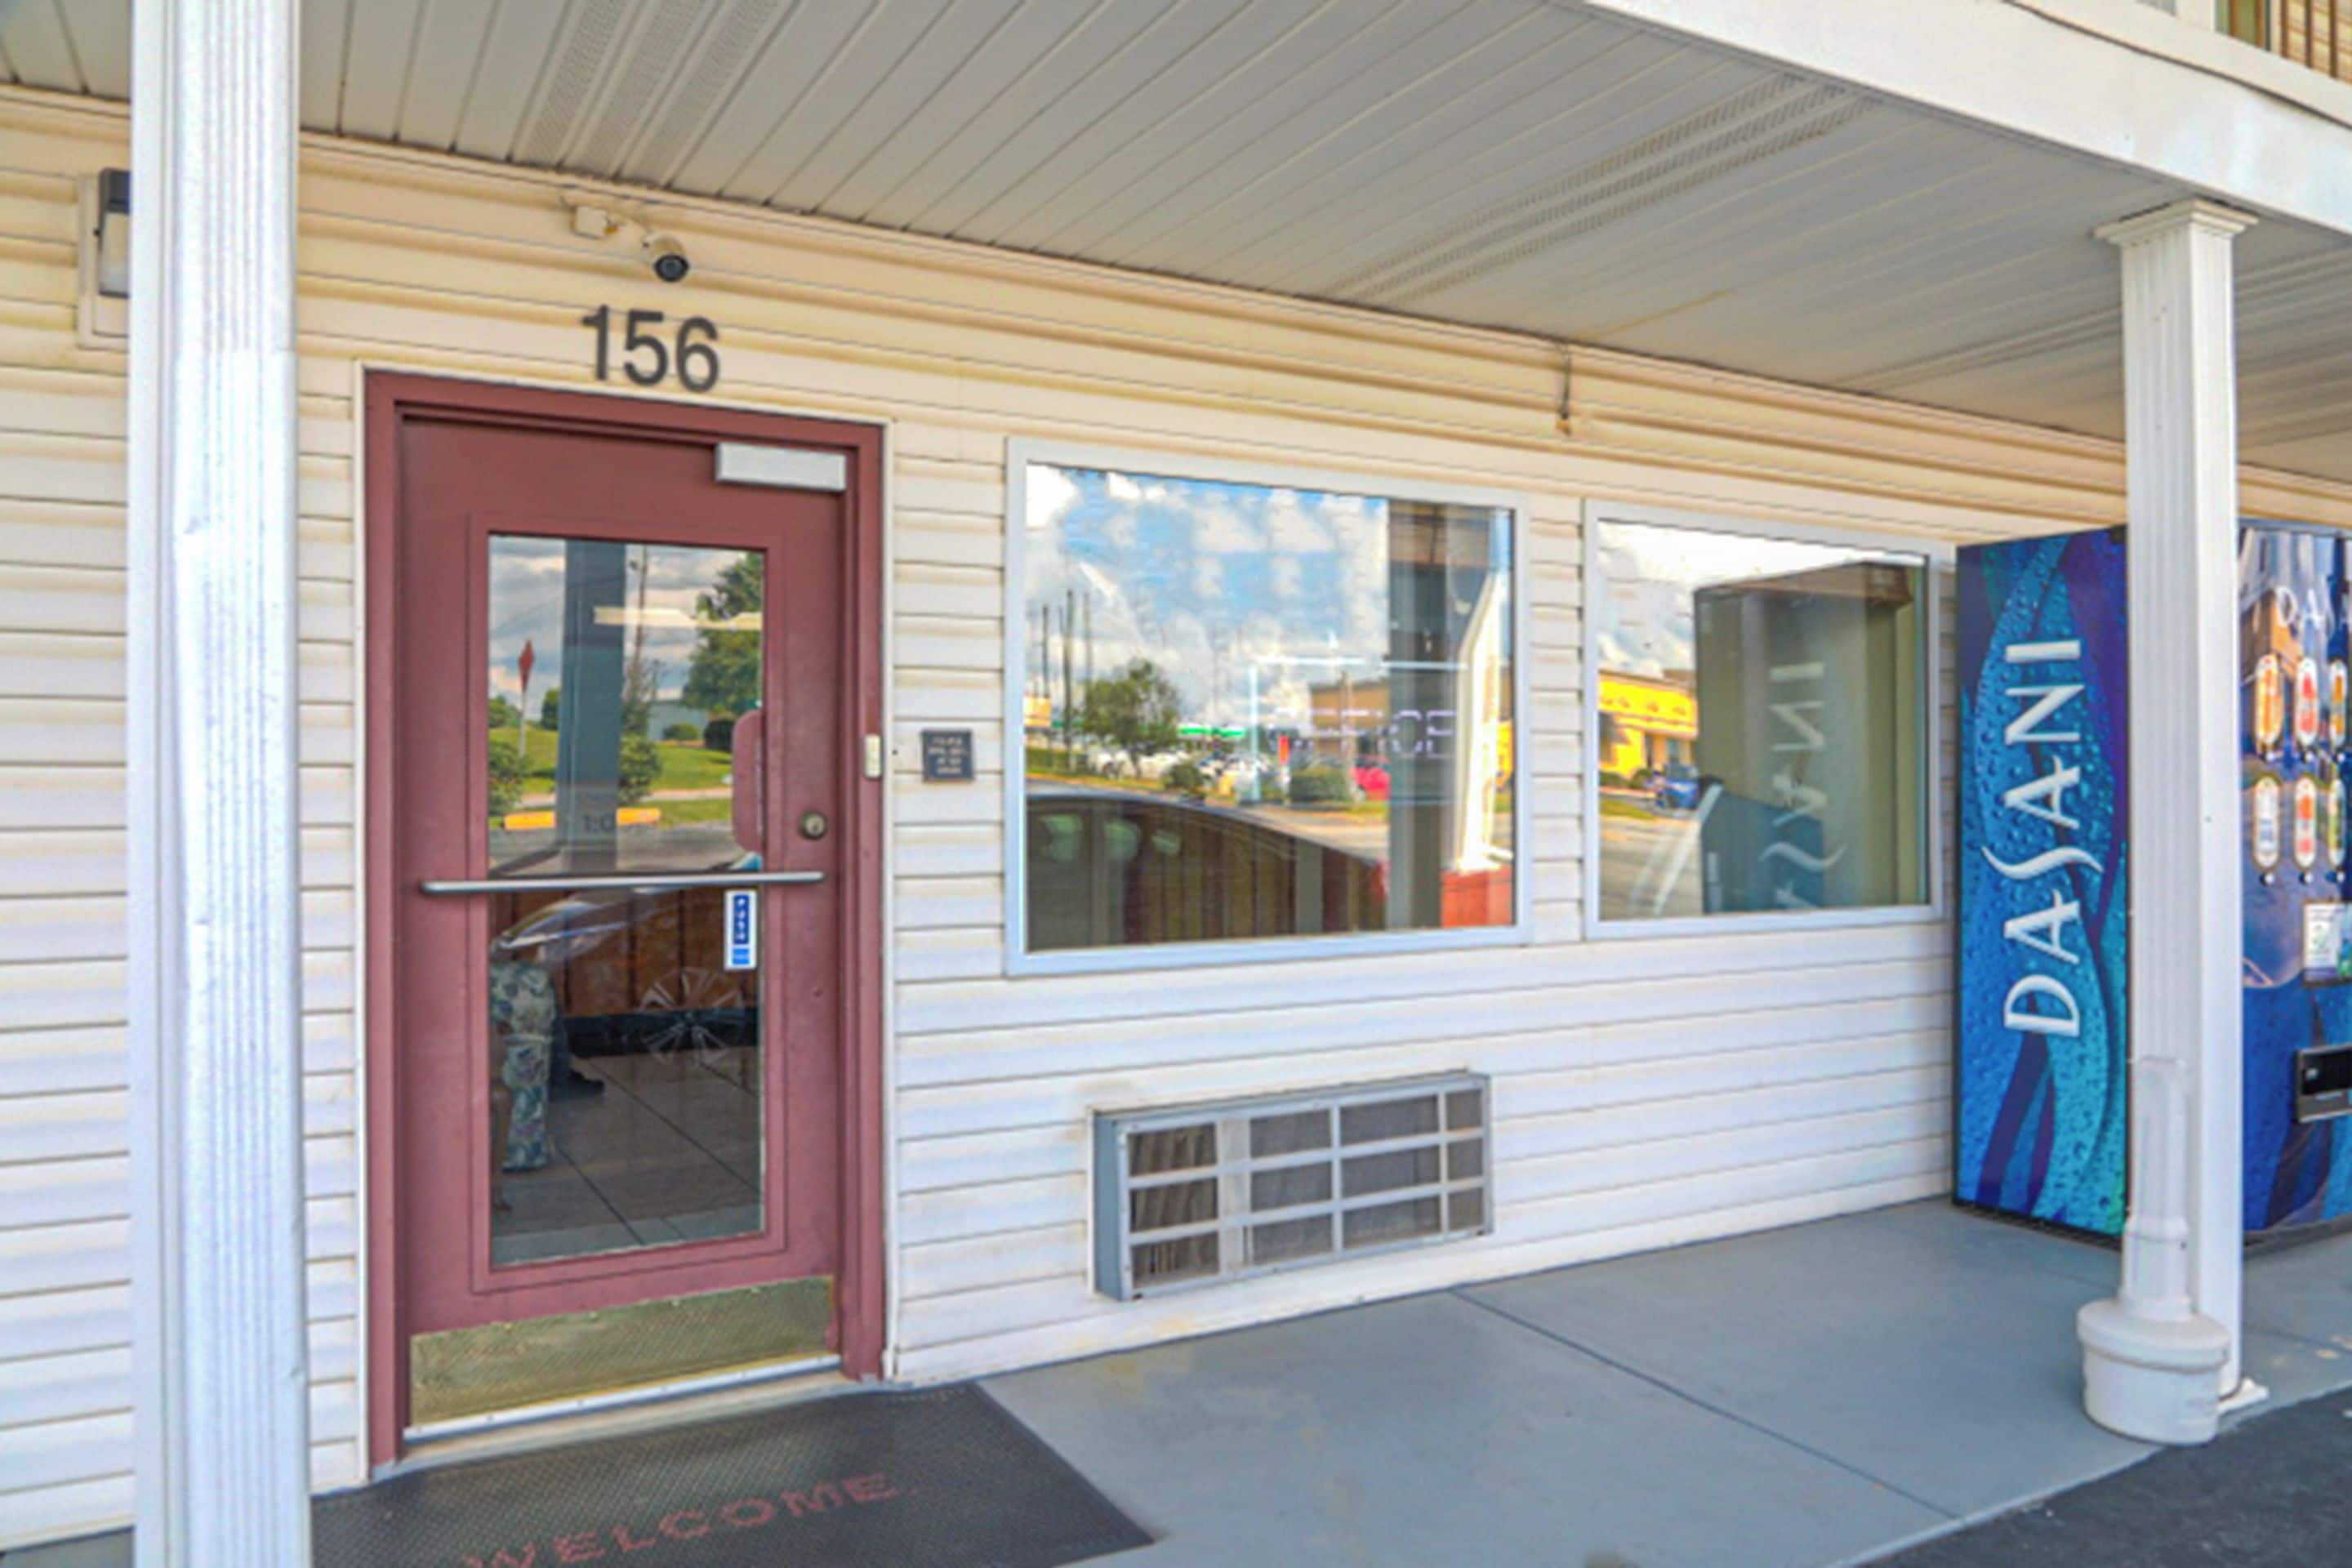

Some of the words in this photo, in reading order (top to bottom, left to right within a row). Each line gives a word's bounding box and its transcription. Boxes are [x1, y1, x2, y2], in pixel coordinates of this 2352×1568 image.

[581, 304, 720, 393] 156
[1981, 639, 2105, 1038] DASANI
[462, 1472, 898, 1568] WELCOME
